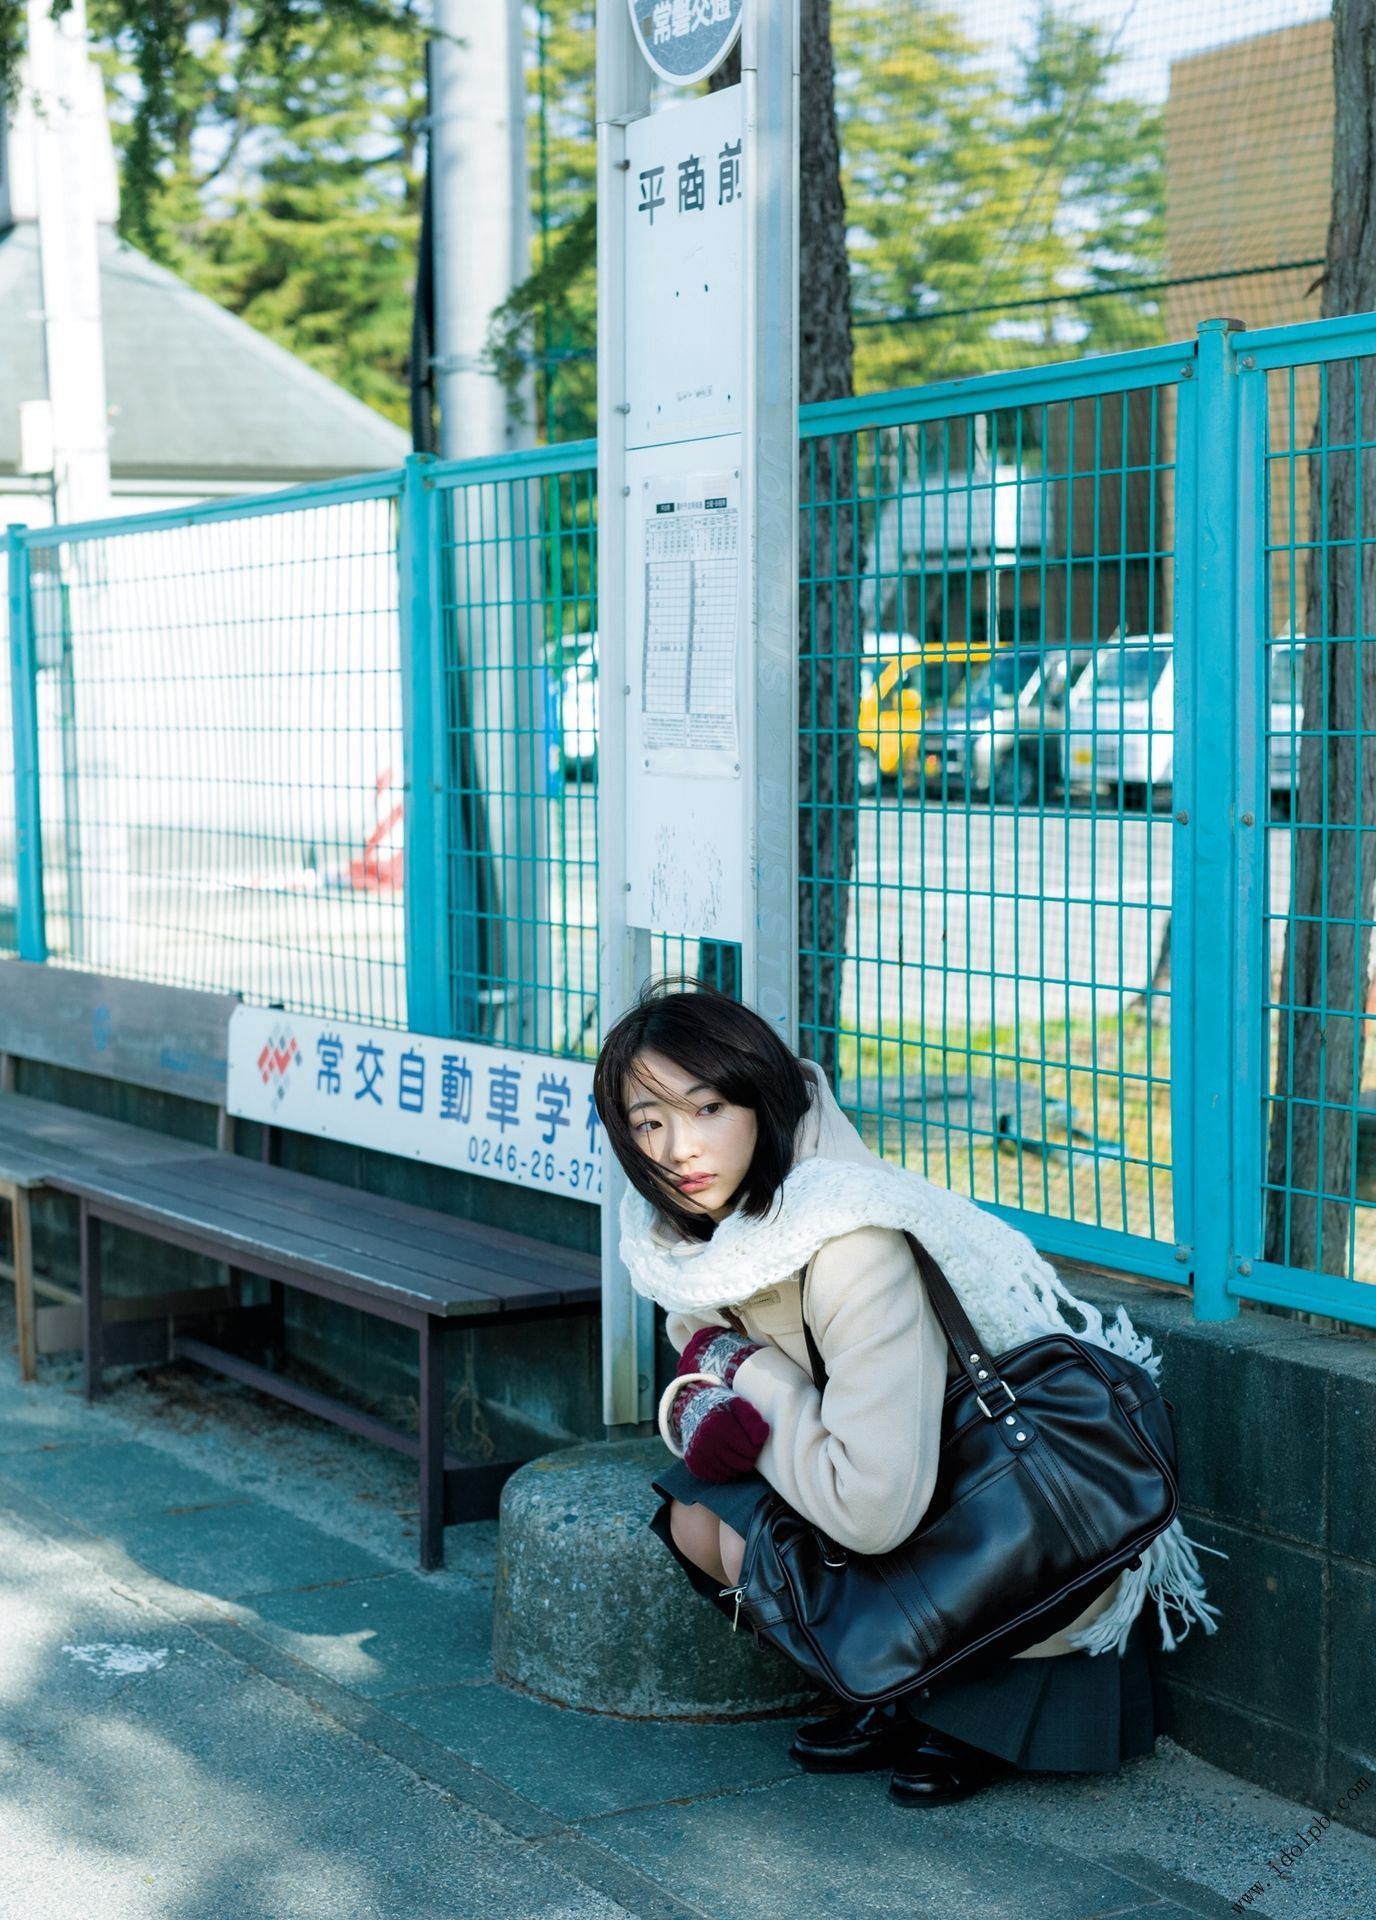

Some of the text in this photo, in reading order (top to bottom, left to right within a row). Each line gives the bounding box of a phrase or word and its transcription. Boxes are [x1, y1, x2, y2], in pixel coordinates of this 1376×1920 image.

[638, 138, 741, 226] 平商前
[757, 576, 789, 697] BUS
[757, 775, 788, 1042] BUS STO
